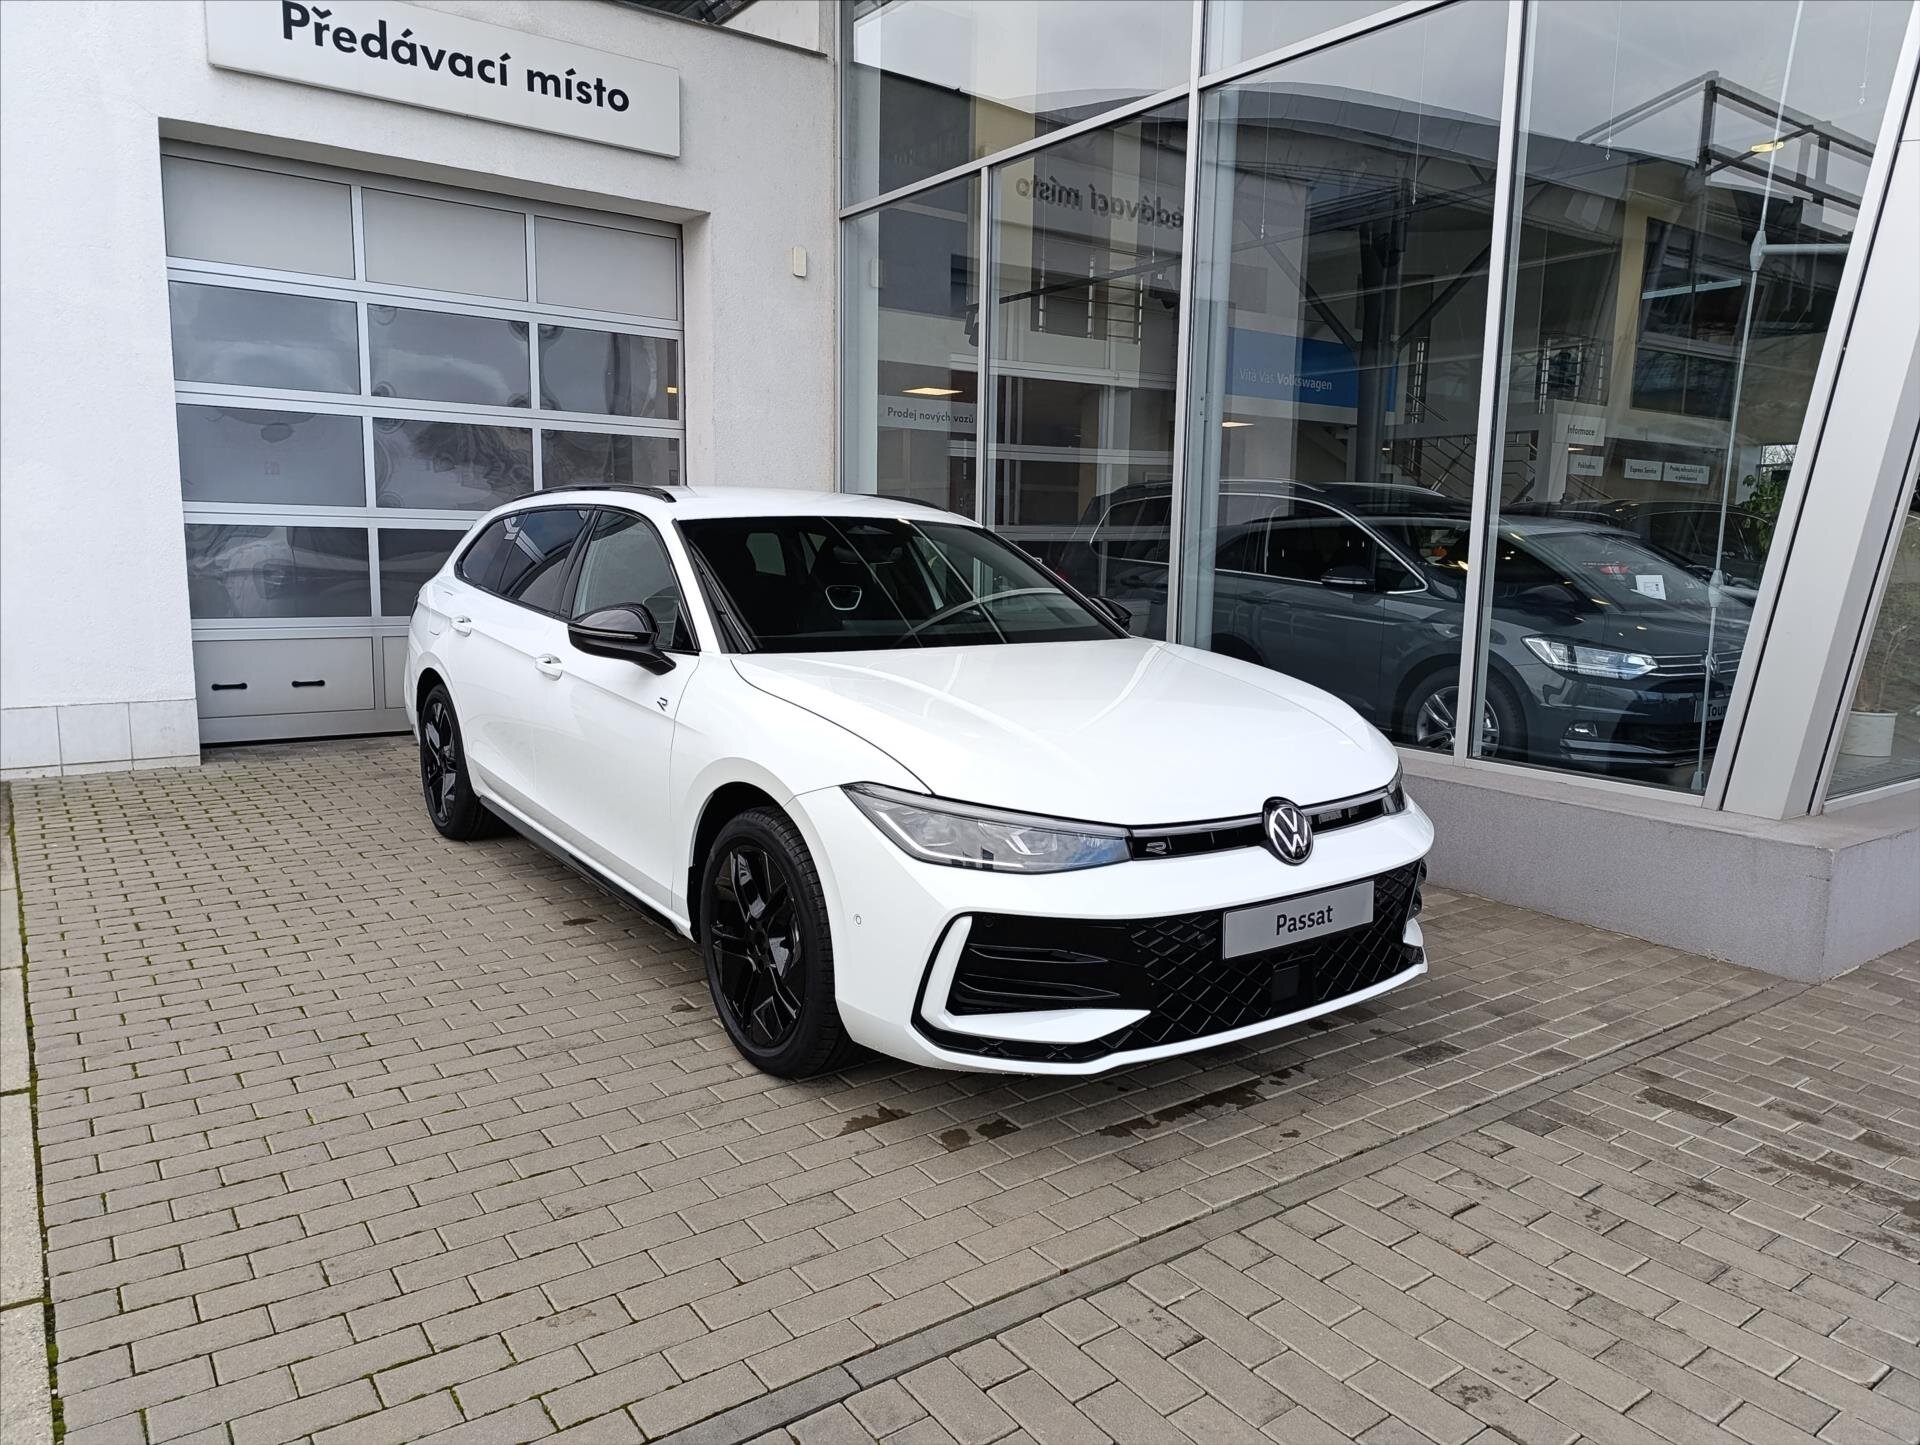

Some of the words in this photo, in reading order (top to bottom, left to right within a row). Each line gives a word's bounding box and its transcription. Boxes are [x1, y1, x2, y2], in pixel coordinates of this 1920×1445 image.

[282, 1, 511, 87] Předávací
[526, 68, 630, 112] místo
[1276, 371, 1333, 392] Volkswagen
[887, 406, 917, 421] Prodej
[919, 411, 951, 423] nových
[952, 414, 974, 424] vozů
[1567, 424, 1596, 437] Informace
[1275, 905, 1334, 936] Passat
